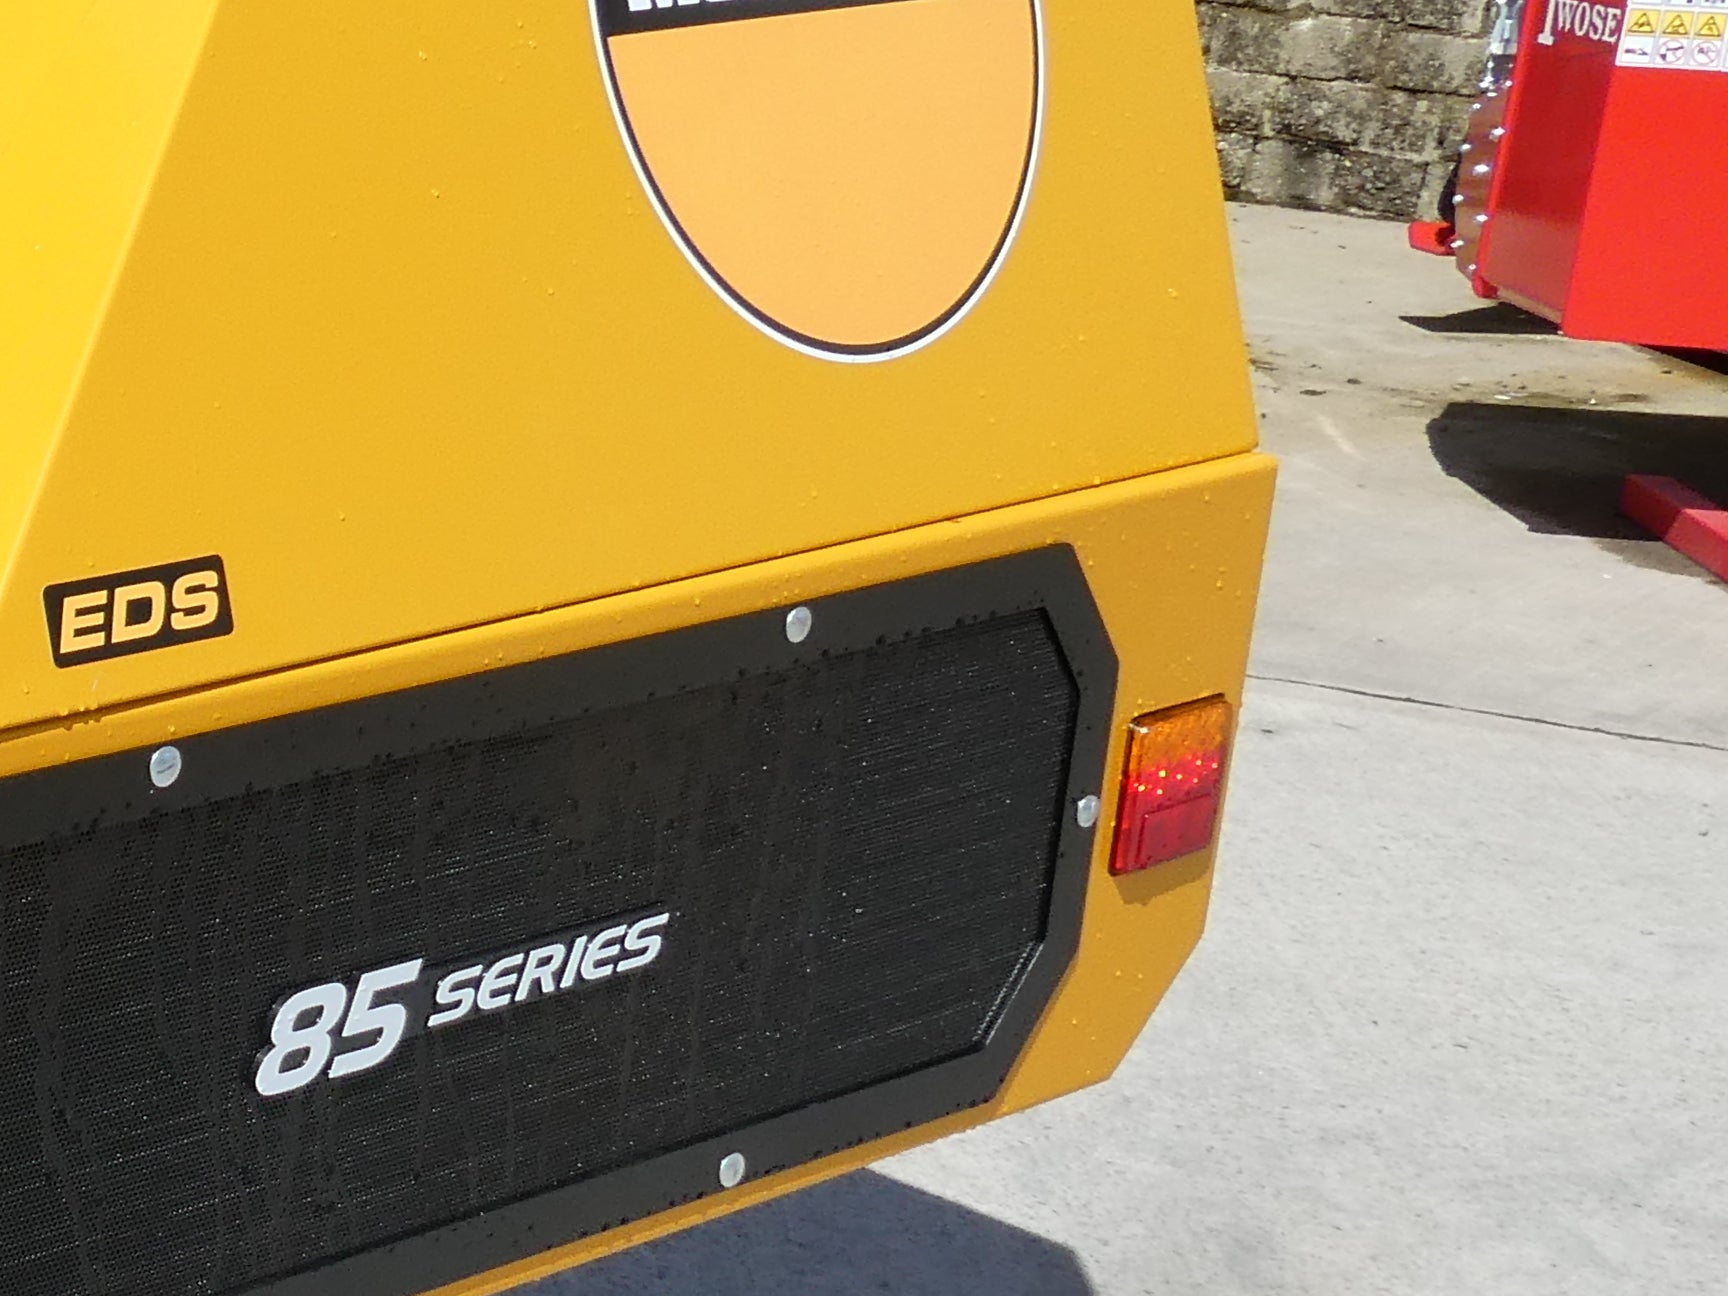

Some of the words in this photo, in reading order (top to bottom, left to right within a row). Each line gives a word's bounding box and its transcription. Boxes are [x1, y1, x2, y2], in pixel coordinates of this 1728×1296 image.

[60, 570, 219, 654] EDS
[255, 958, 423, 1096] 85
[427, 912, 670, 1027] SERIES
